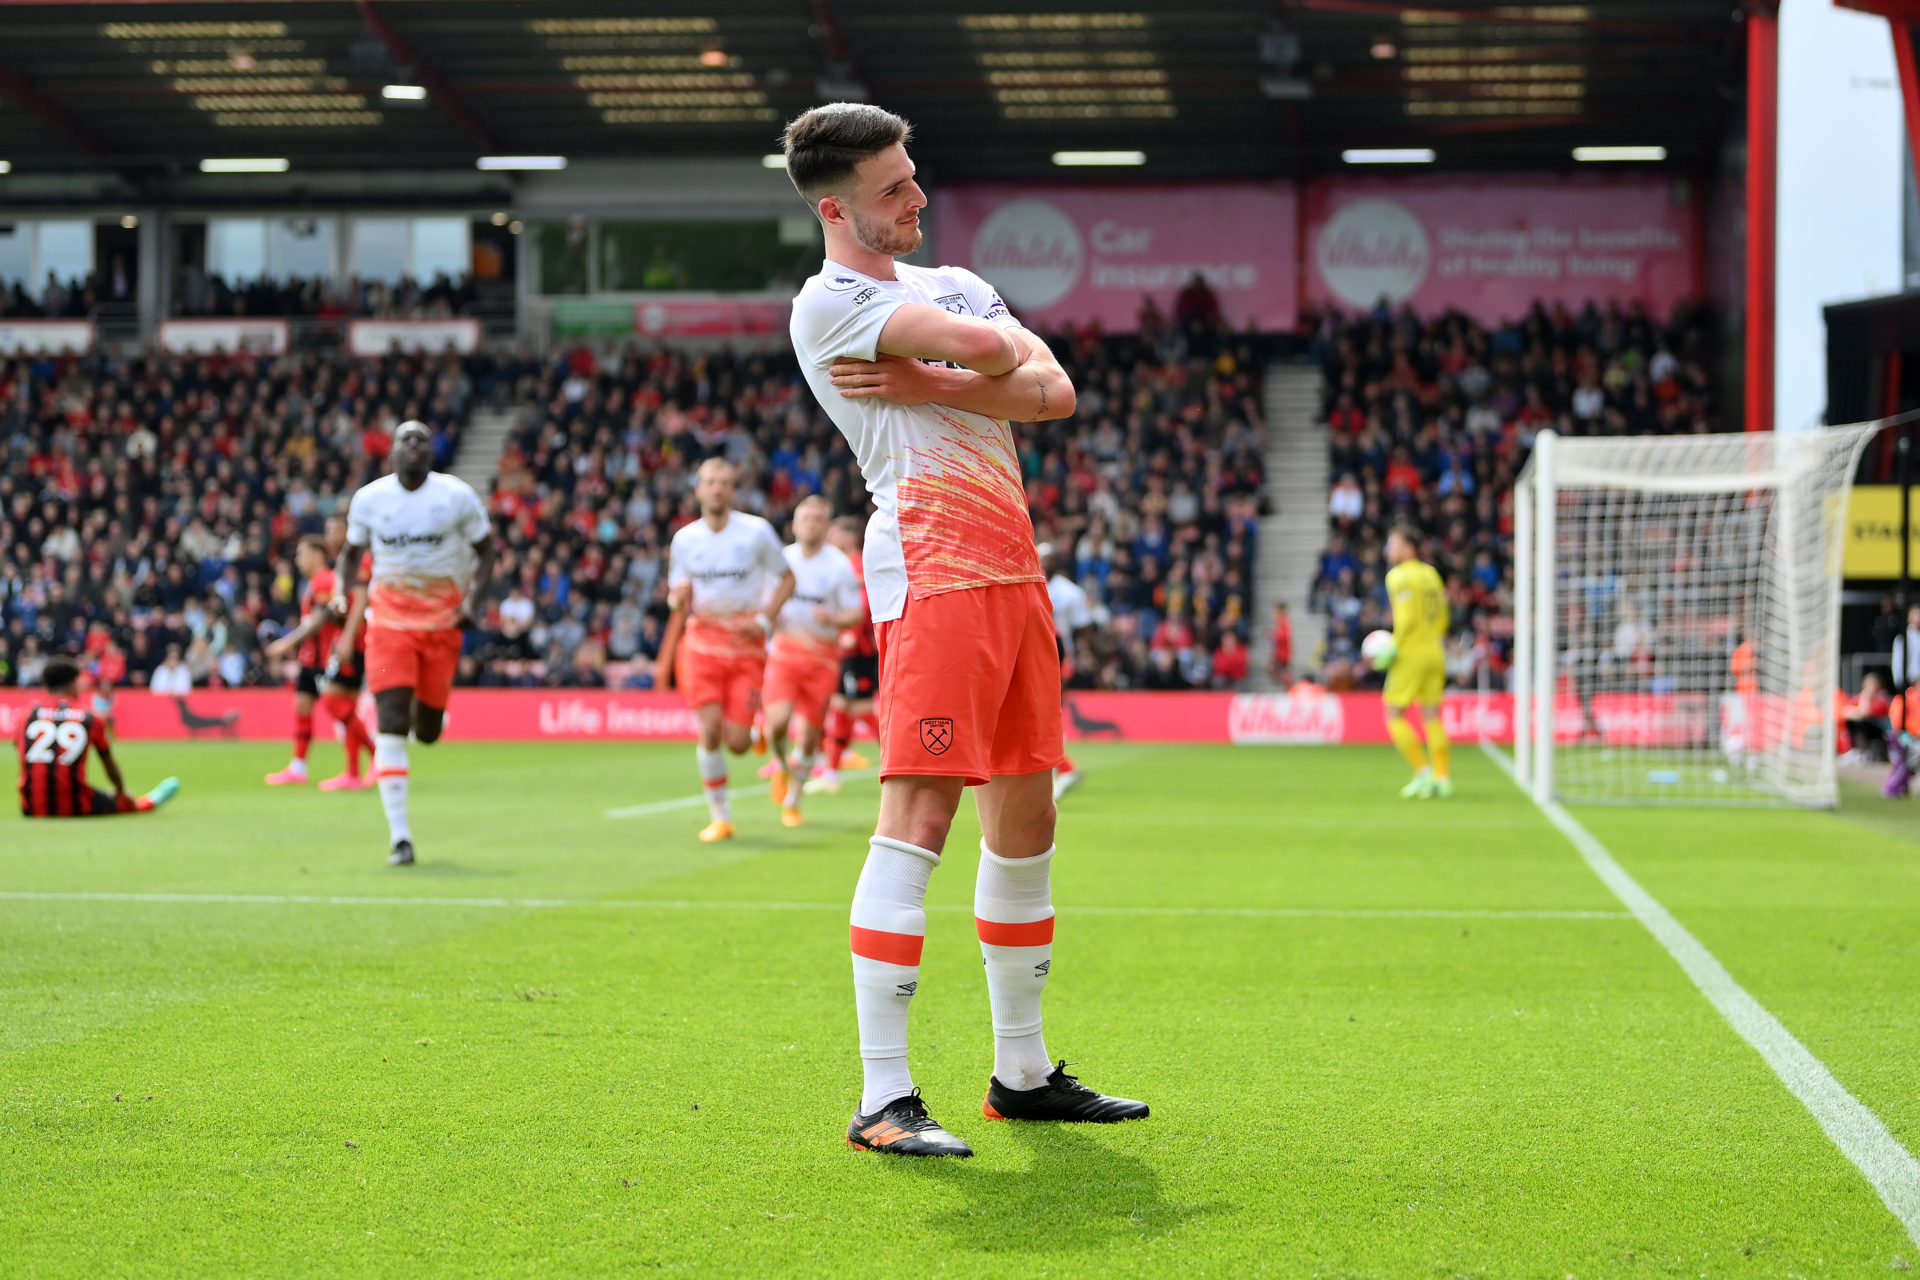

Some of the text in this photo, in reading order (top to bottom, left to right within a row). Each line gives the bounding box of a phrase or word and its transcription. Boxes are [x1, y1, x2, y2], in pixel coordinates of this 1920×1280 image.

[1091, 220, 1152, 252] Car
[1533, 225, 1572, 248] the
[1578, 224, 1680, 248] benefits
[1439, 254, 1464, 276] of
[1567, 254, 1637, 283] living
[539, 700, 601, 733] Life
[26, 719, 88, 765] 29
